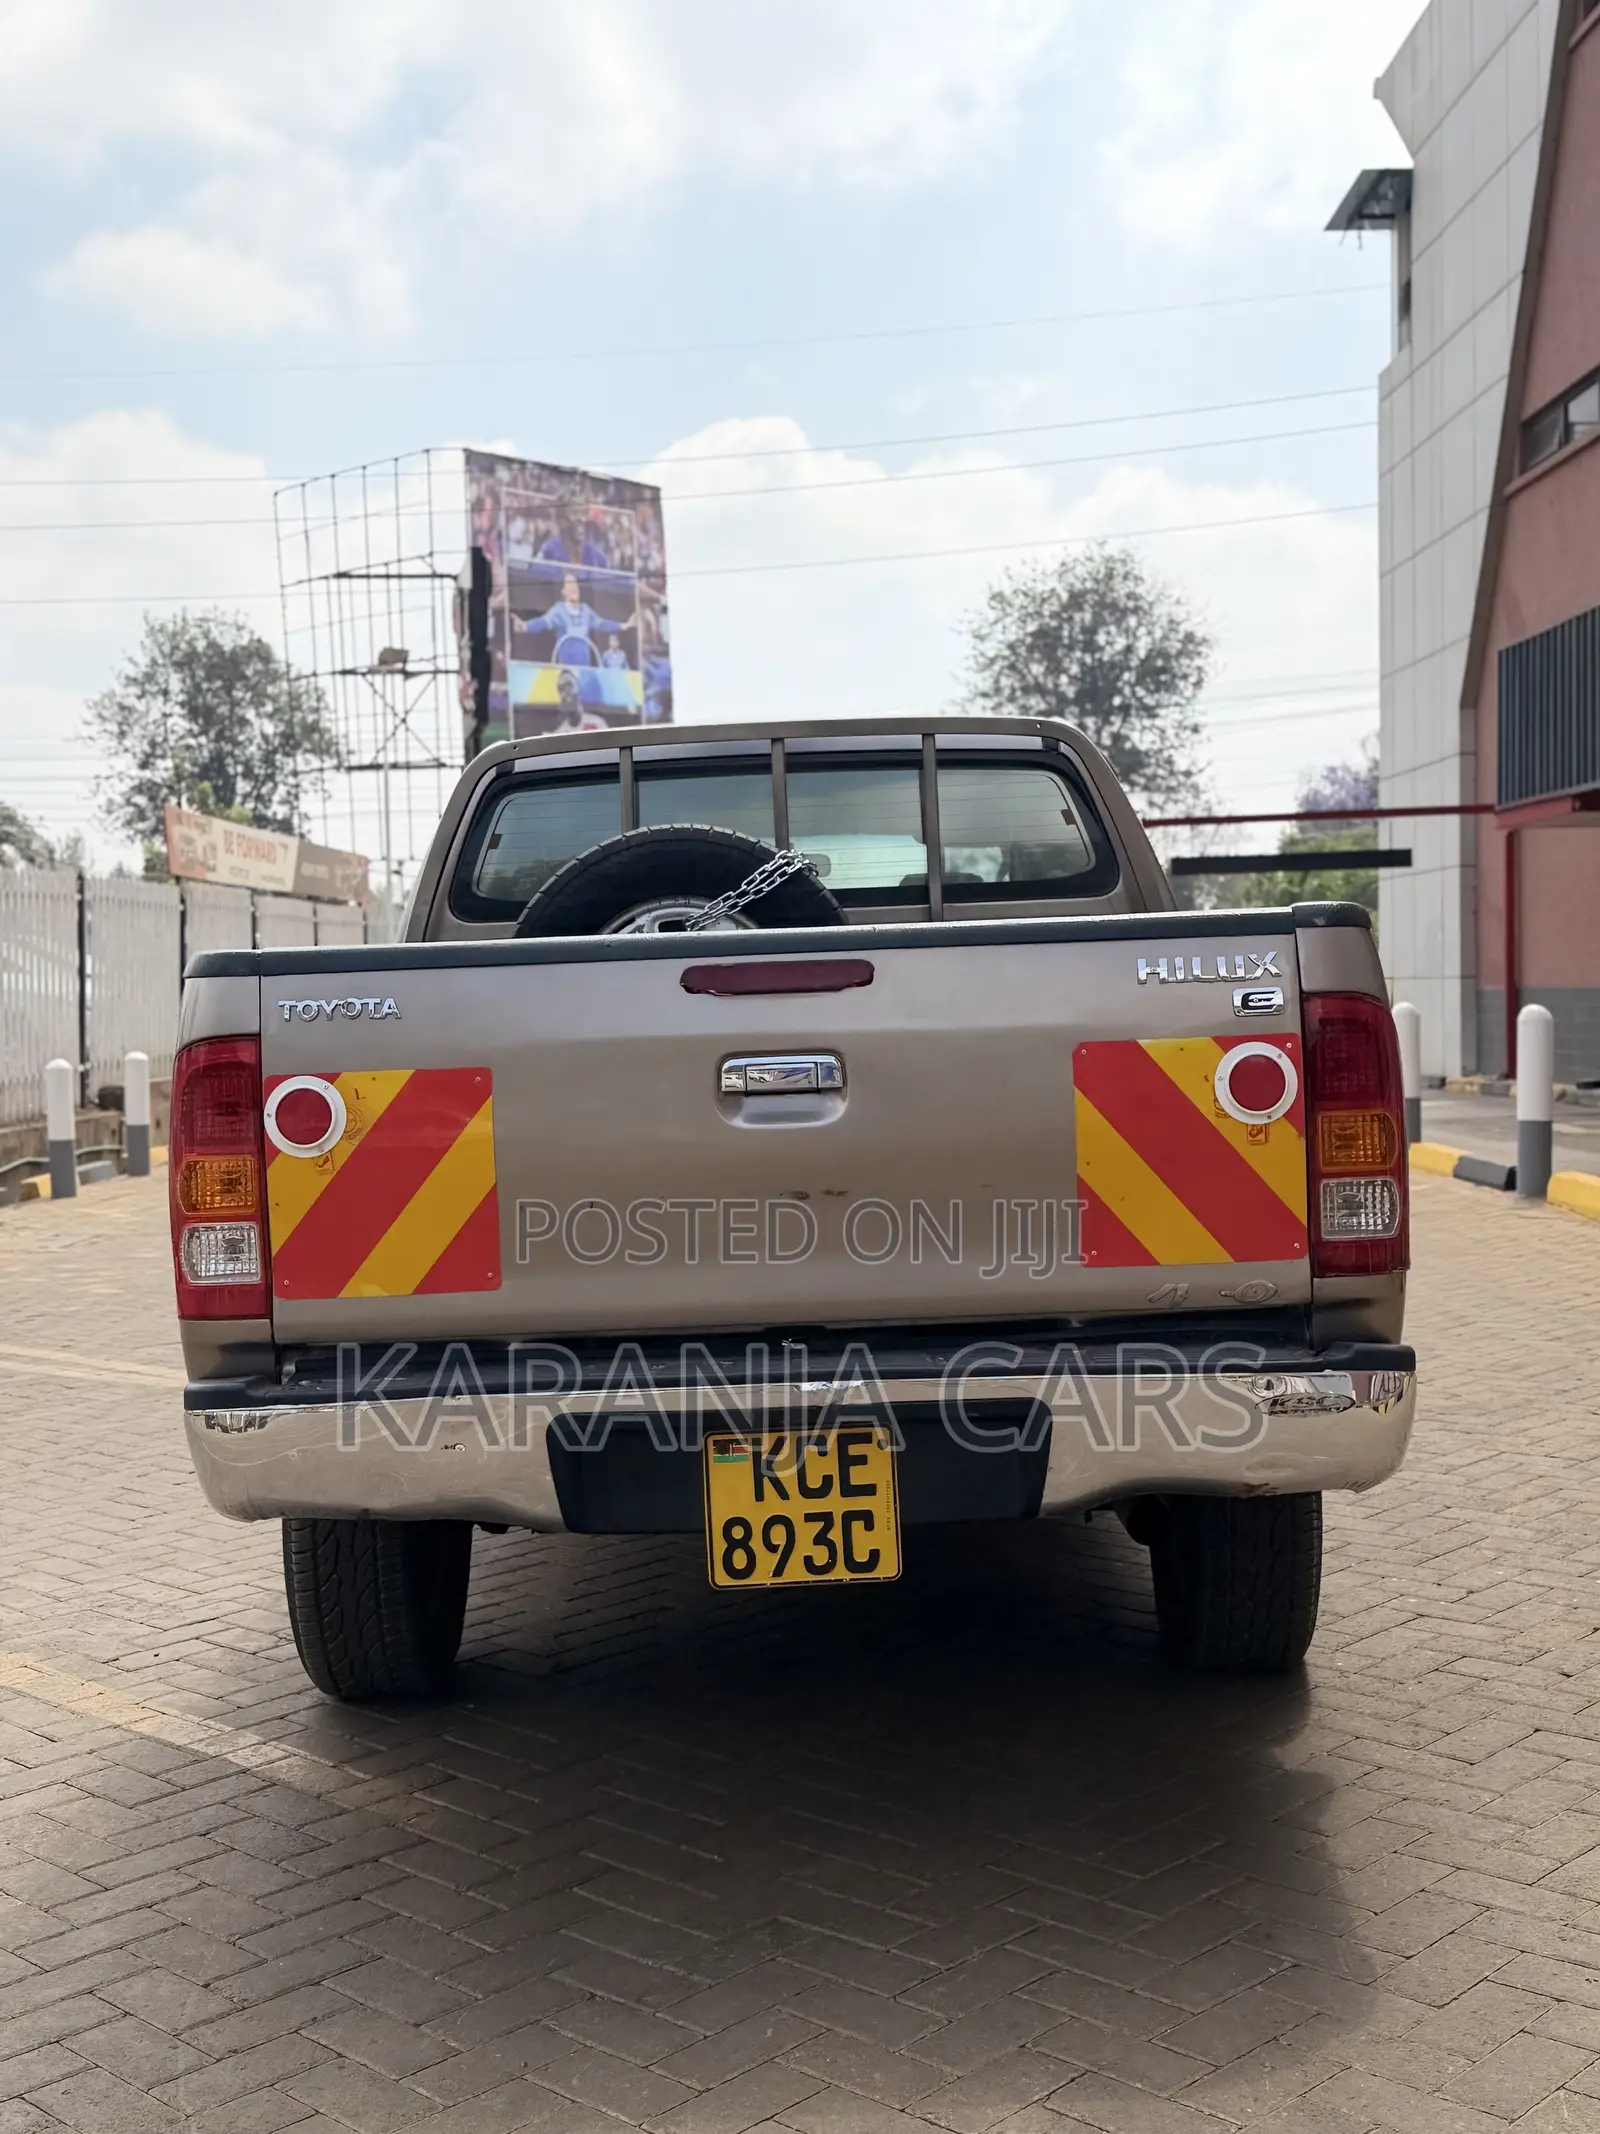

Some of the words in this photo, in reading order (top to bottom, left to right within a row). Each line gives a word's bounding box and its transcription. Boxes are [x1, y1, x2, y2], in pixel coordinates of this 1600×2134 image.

[1137, 951, 1283, 985] HILUX
[278, 998, 402, 1022] TOYOTA
[752, 1432, 877, 1502] KCE
[722, 1509, 881, 1580] 893C
